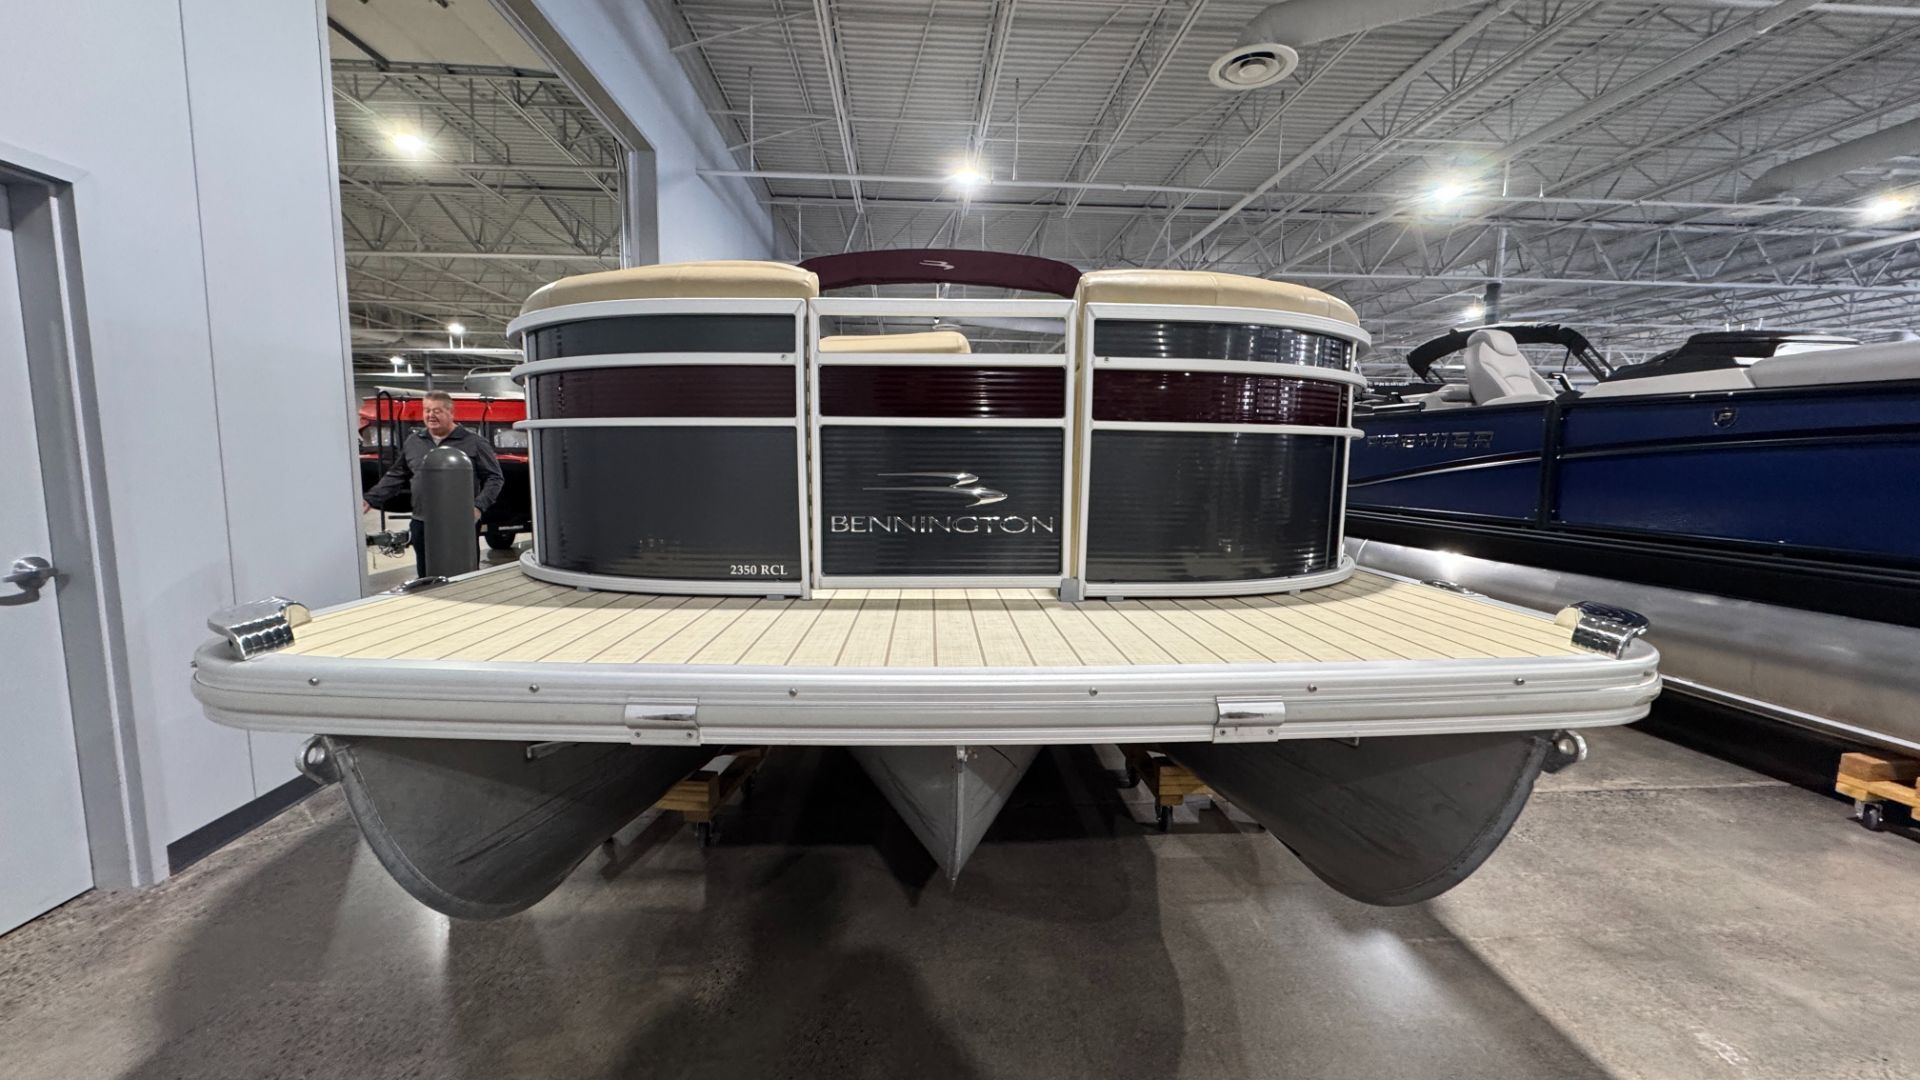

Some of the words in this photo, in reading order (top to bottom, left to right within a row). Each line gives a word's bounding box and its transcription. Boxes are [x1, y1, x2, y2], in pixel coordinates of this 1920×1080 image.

[830, 515, 1054, 533] BENNINGTON
[730, 564, 757, 576] 2350
[760, 564, 788, 576] RCL
